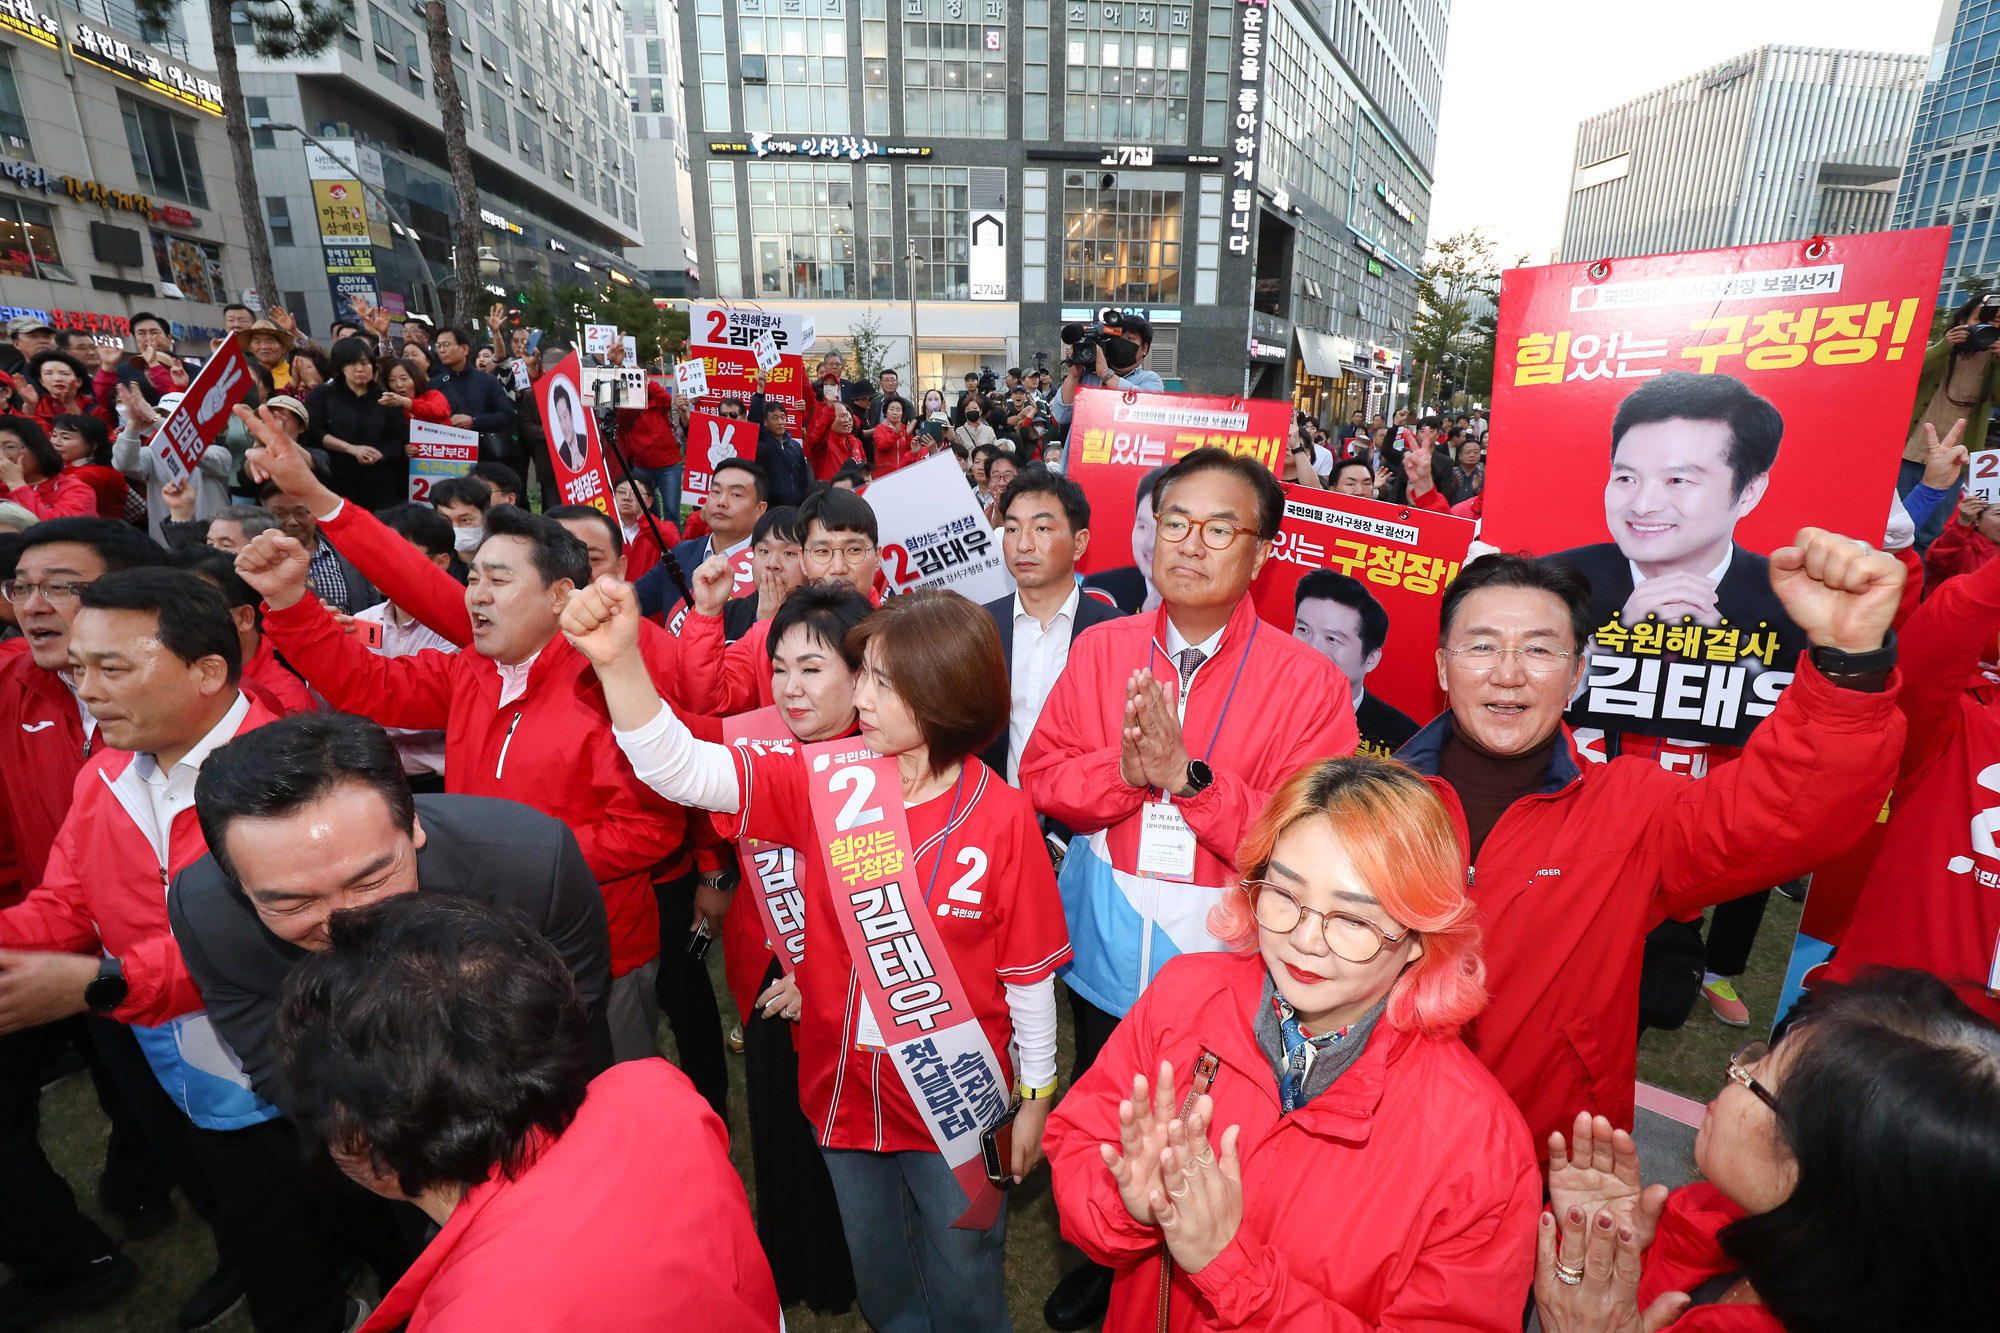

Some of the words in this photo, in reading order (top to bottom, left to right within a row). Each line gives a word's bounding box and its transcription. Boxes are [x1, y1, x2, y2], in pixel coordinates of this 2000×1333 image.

[0, 0, 37, 27] 원
[39, 13, 59, 35] 3F
[1069, 5, 1190, 28] 소아치과
[1239, 7, 1264, 81] 운동을
[77, 24, 163, 81] 휴먼피부과
[167, 64, 225, 107] 에스테틱
[1233, 88, 1259, 182] 좋아하게
[1101, 146, 1153, 166] 고기집
[60, 175, 154, 220] 간장게장
[322, 206, 350, 221] 마곡
[326, 222, 366, 236] 삼계탕
[1229, 188, 1252, 256] 됩니다
[336, 284, 373, 292] COFFEE
[338, 276, 368, 284] EDIYA
[972, 284, 1005, 295] 고기집
[1761, 271, 1836, 292] 보궐선거
[588, 327, 599, 339] 2
[706, 310, 728, 344] 2
[729, 312, 782, 329] 숙원해결사
[754, 341, 764, 357] 2
[1513, 329, 1668, 387] 힘있는
[1681, 297, 1920, 375] 구청장!
[678, 365, 688, 383] 2
[703, 356, 744, 376] 힘있는
[168, 406, 205, 463] 김태우
[1168, 412, 1209, 427] 강서구청장
[1211, 416, 1246, 430] 보궐선거
[418, 443, 470, 459] 첫날부터
[1081, 427, 1166, 467] 힘있는
[1976, 453, 1999, 479] 2
[412, 477, 430, 503] 2
[564, 468, 603, 506] 구청장은
[904, 530, 940, 552] 힘있는
[937, 514, 977, 539] 구청장
[1287, 504, 1323, 522] 국민의힘
[1325, 512, 1373, 532] 강서구청장
[1374, 523, 1416, 542] 보궐선거
[881, 543, 921, 586] 2
[912, 530, 993, 578] 김태우
[1269, 532, 1325, 569] 있는
[945, 564, 984, 583] 강서구청장
[985, 557, 1001, 569] 후보
[1595, 613, 1780, 666] 숙원해결사
[828, 765, 885, 833] 2
[828, 829, 896, 868] 힘있는
[841, 850, 905, 887] 구청장
[947, 846, 988, 905] 2
[951, 907, 983, 920] 국민의힘
[849, 882, 952, 1031] 김태우
[901, 1037, 978, 1142] 첫날부터
